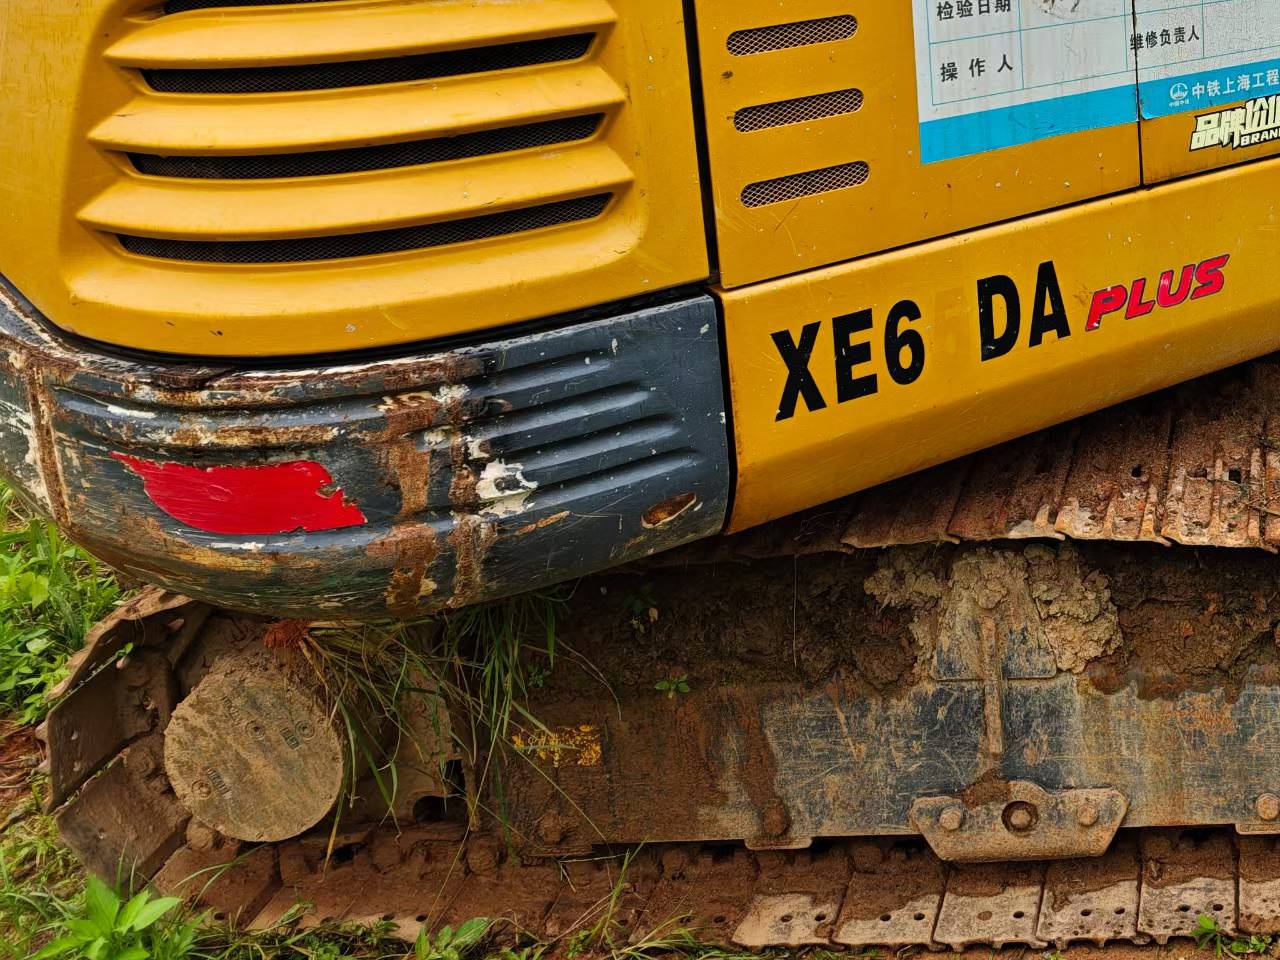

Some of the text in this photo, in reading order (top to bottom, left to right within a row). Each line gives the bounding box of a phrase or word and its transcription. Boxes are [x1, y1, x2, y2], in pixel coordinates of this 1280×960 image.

[1130, 25, 1200, 51] 维修负责人
[1085, 253, 1231, 332] PLUS
